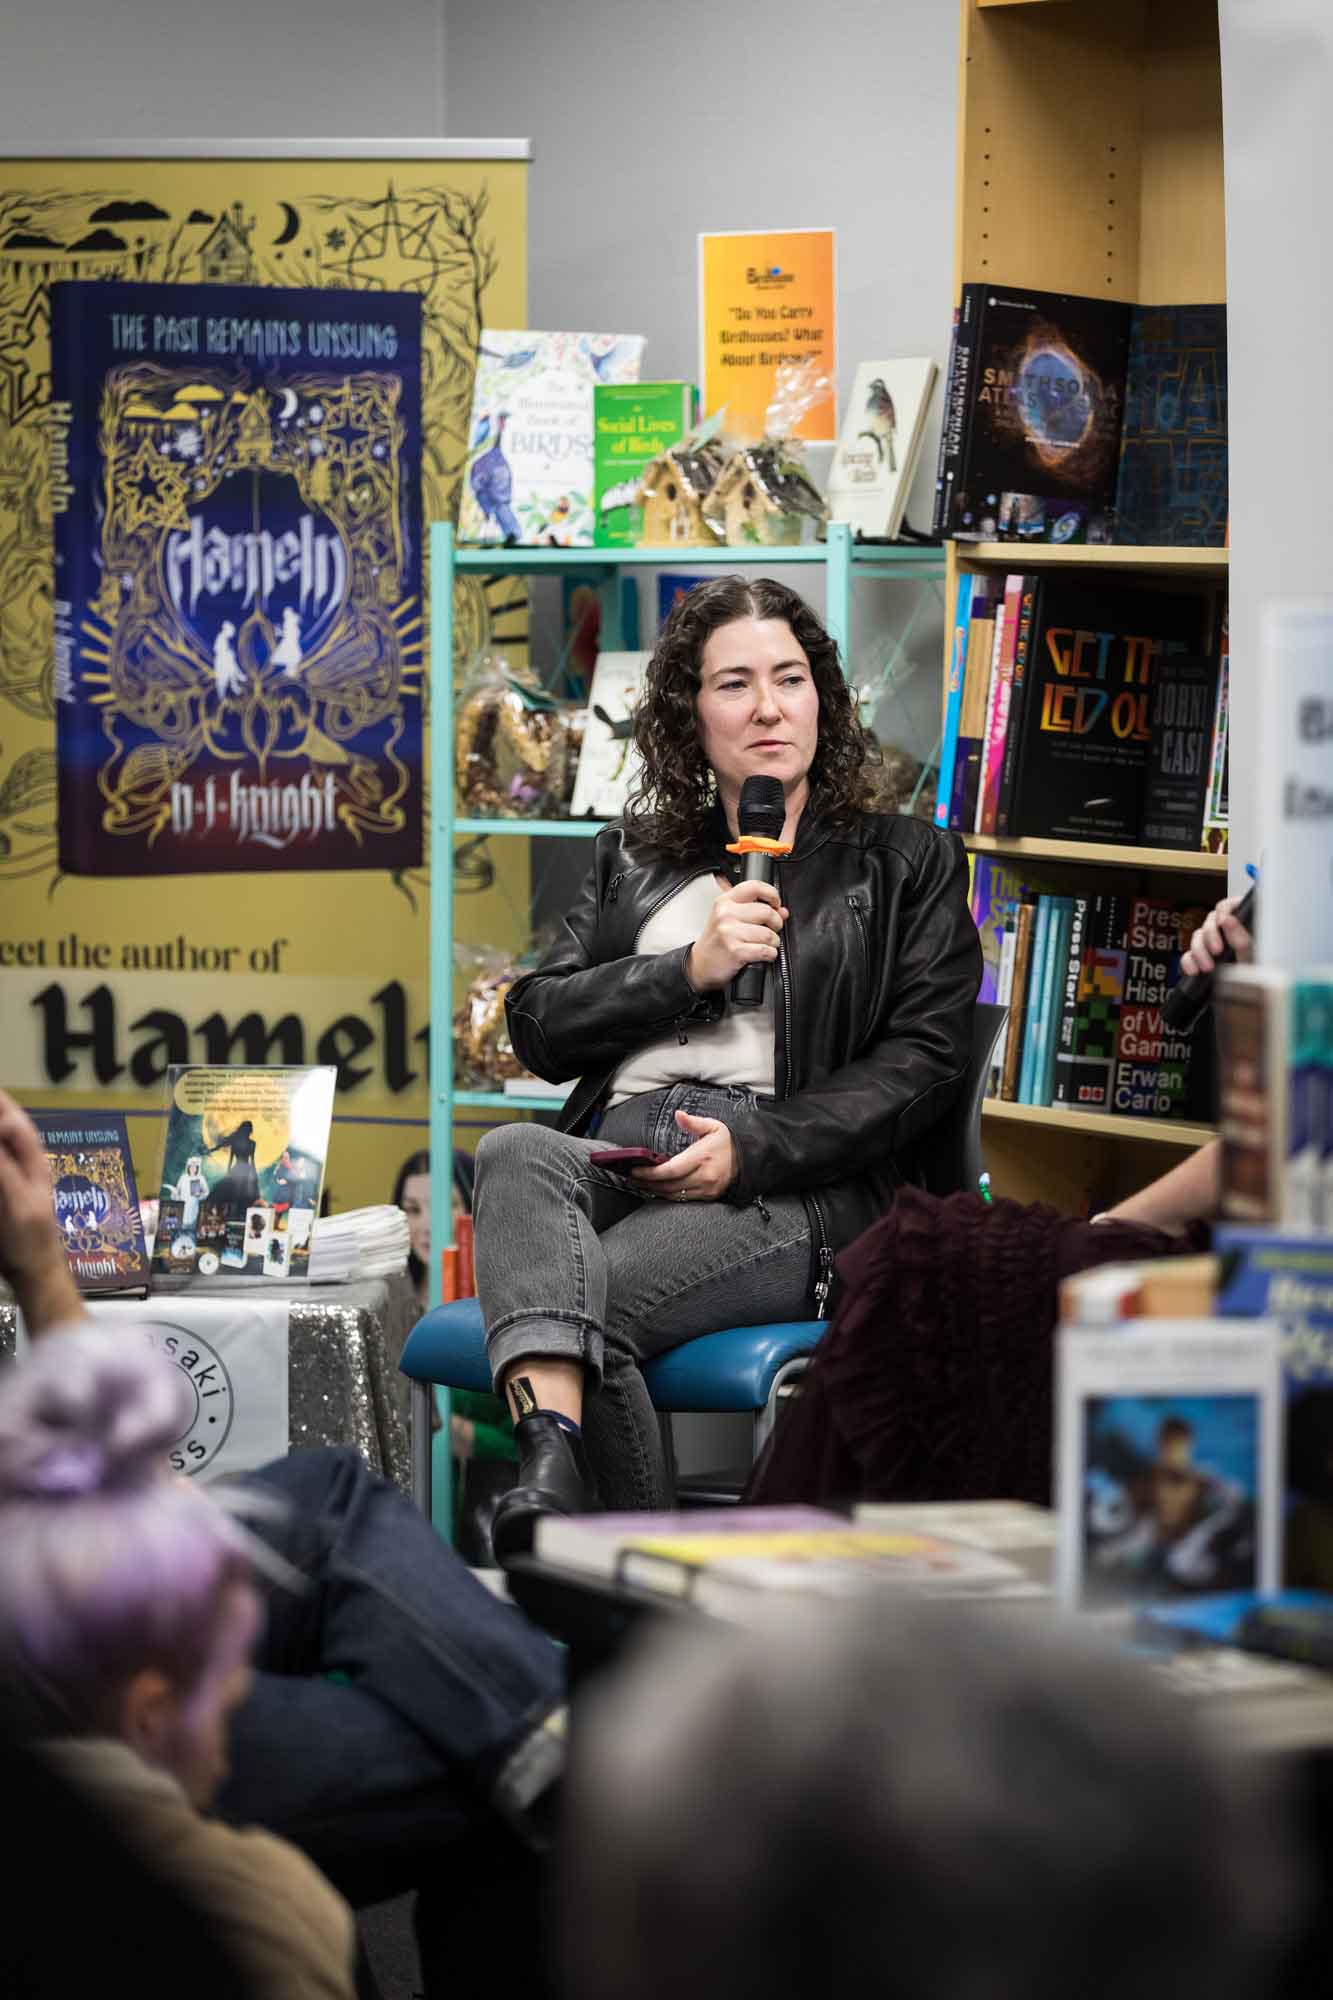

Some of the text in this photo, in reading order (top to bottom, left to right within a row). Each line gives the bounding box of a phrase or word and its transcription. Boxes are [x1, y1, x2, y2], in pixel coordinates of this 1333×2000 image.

[780, 306, 814, 321] Carry
[110, 313, 399, 360] THE PAST REMAINS UNSUNG
[793, 328, 823, 341] What
[639, 416, 676, 432] Lives
[167, 514, 348, 620] Hameln
[1045, 628, 1115, 679] GET
[1040, 682, 1108, 735] LED
[1153, 681, 1209, 726] JOHN
[1071, 900, 1088, 954] Press
[1133, 903, 1195, 928] Press
[0, 933, 288, 973] eet the author of
[1130, 956, 1167, 981] The
[1065, 960, 1081, 1008] Start
[1126, 980, 1171, 1004] Hist
[1123, 1011, 1145, 1033] of
[1117, 1064, 1182, 1089] Erwan
[1115, 1087, 1170, 1112] Cario
[55, 1187, 109, 1218] ameln
